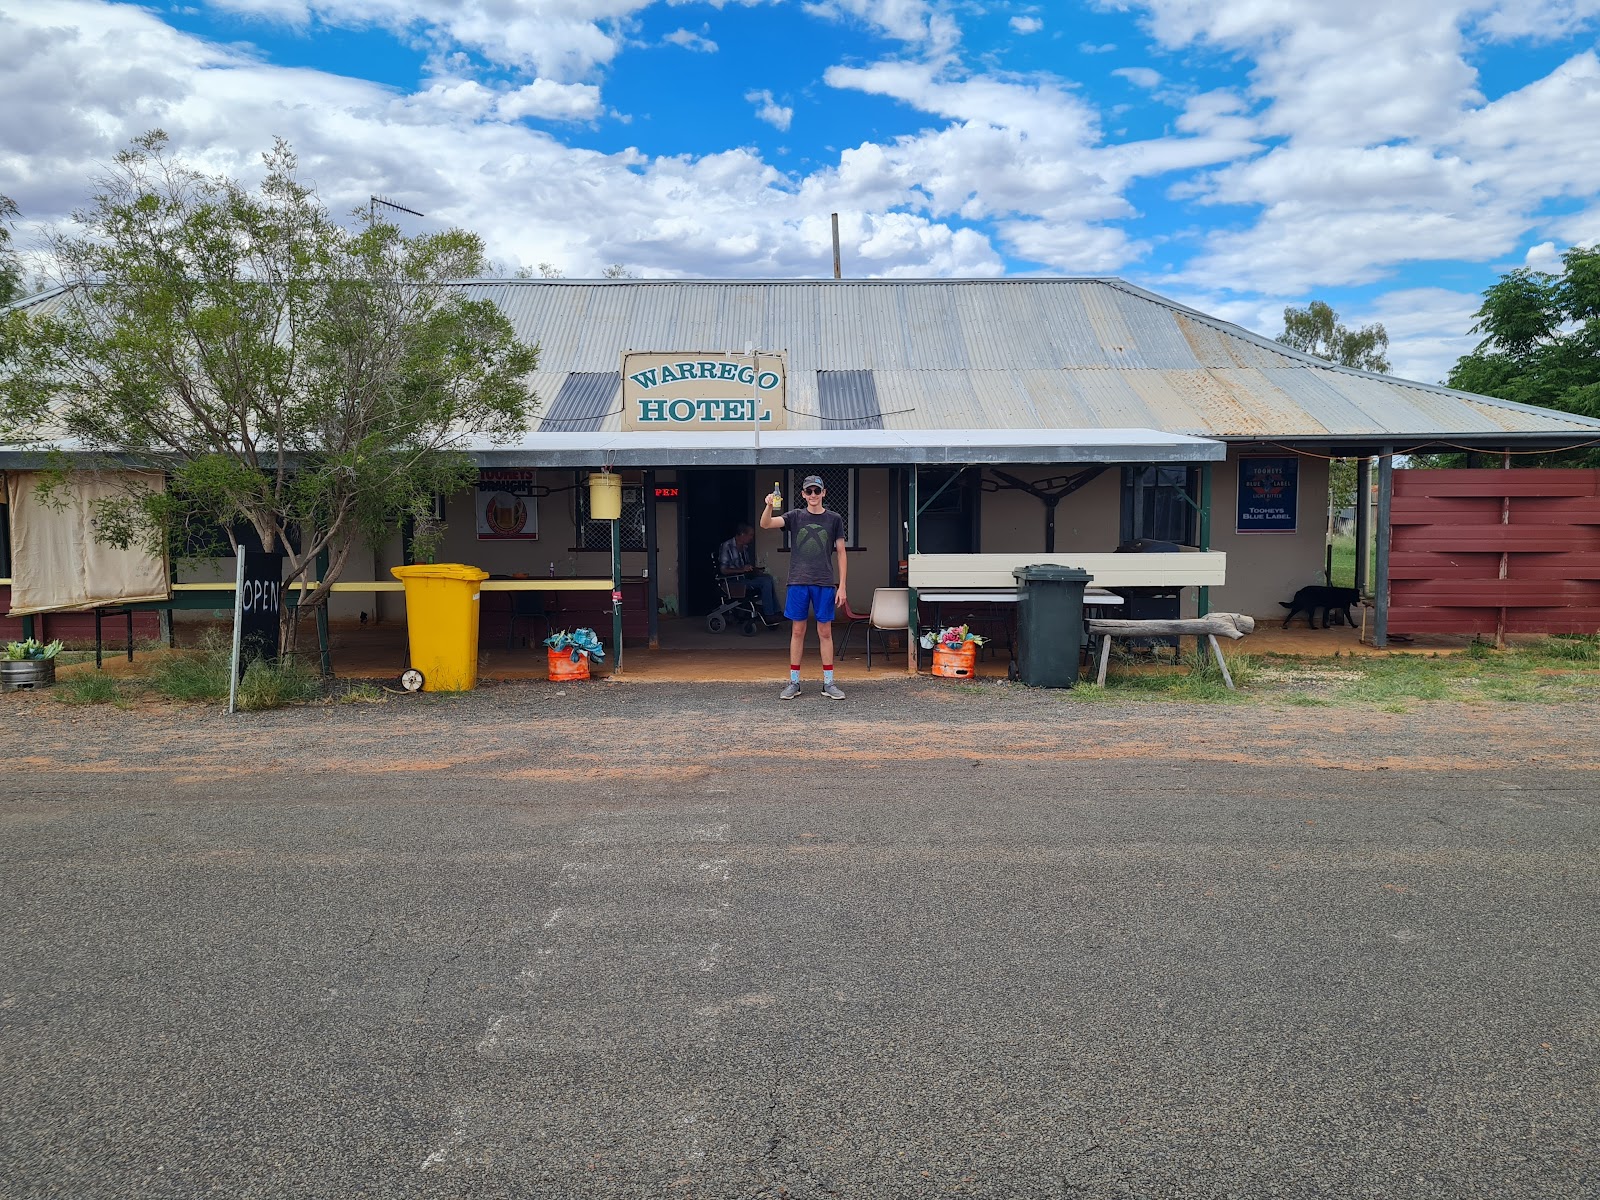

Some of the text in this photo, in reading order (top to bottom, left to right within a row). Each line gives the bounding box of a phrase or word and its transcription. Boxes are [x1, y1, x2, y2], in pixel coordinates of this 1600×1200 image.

[629, 361, 779, 390] WARREGO
[638, 399, 772, 422] HOTEL
[654, 488, 679, 497] PEN
[242, 579, 280, 614] OPEN
